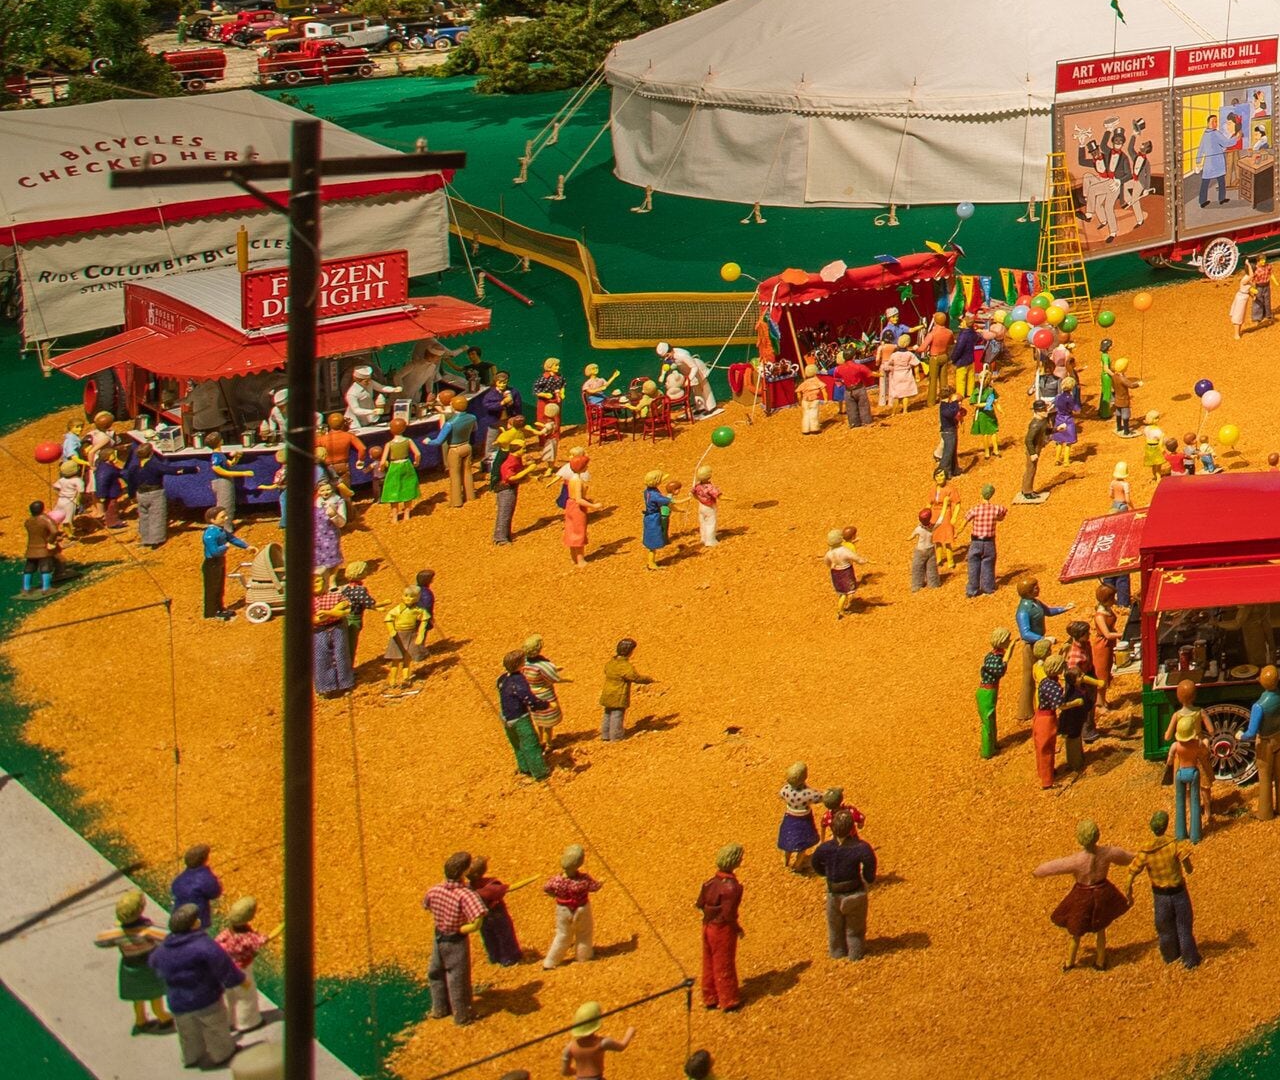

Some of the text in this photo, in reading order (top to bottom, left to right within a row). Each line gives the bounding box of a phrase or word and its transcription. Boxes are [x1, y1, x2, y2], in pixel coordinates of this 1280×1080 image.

[1072, 54, 1155, 80] ART WRIGHT'S
[1189, 43, 1261, 64] EDWARD HILL
[1098, 74, 1120, 83] COLORED
[60, 135, 204, 161] BICYCLES
[18, 152, 167, 188] CHECKED
[38, 270, 78, 283] RIDE
[83, 253, 197, 280] COLUMBIA
[203, 238, 291, 263] BICCLES
[271, 262, 385, 296] FZEN
[262, 281, 389, 318] DIGHT
